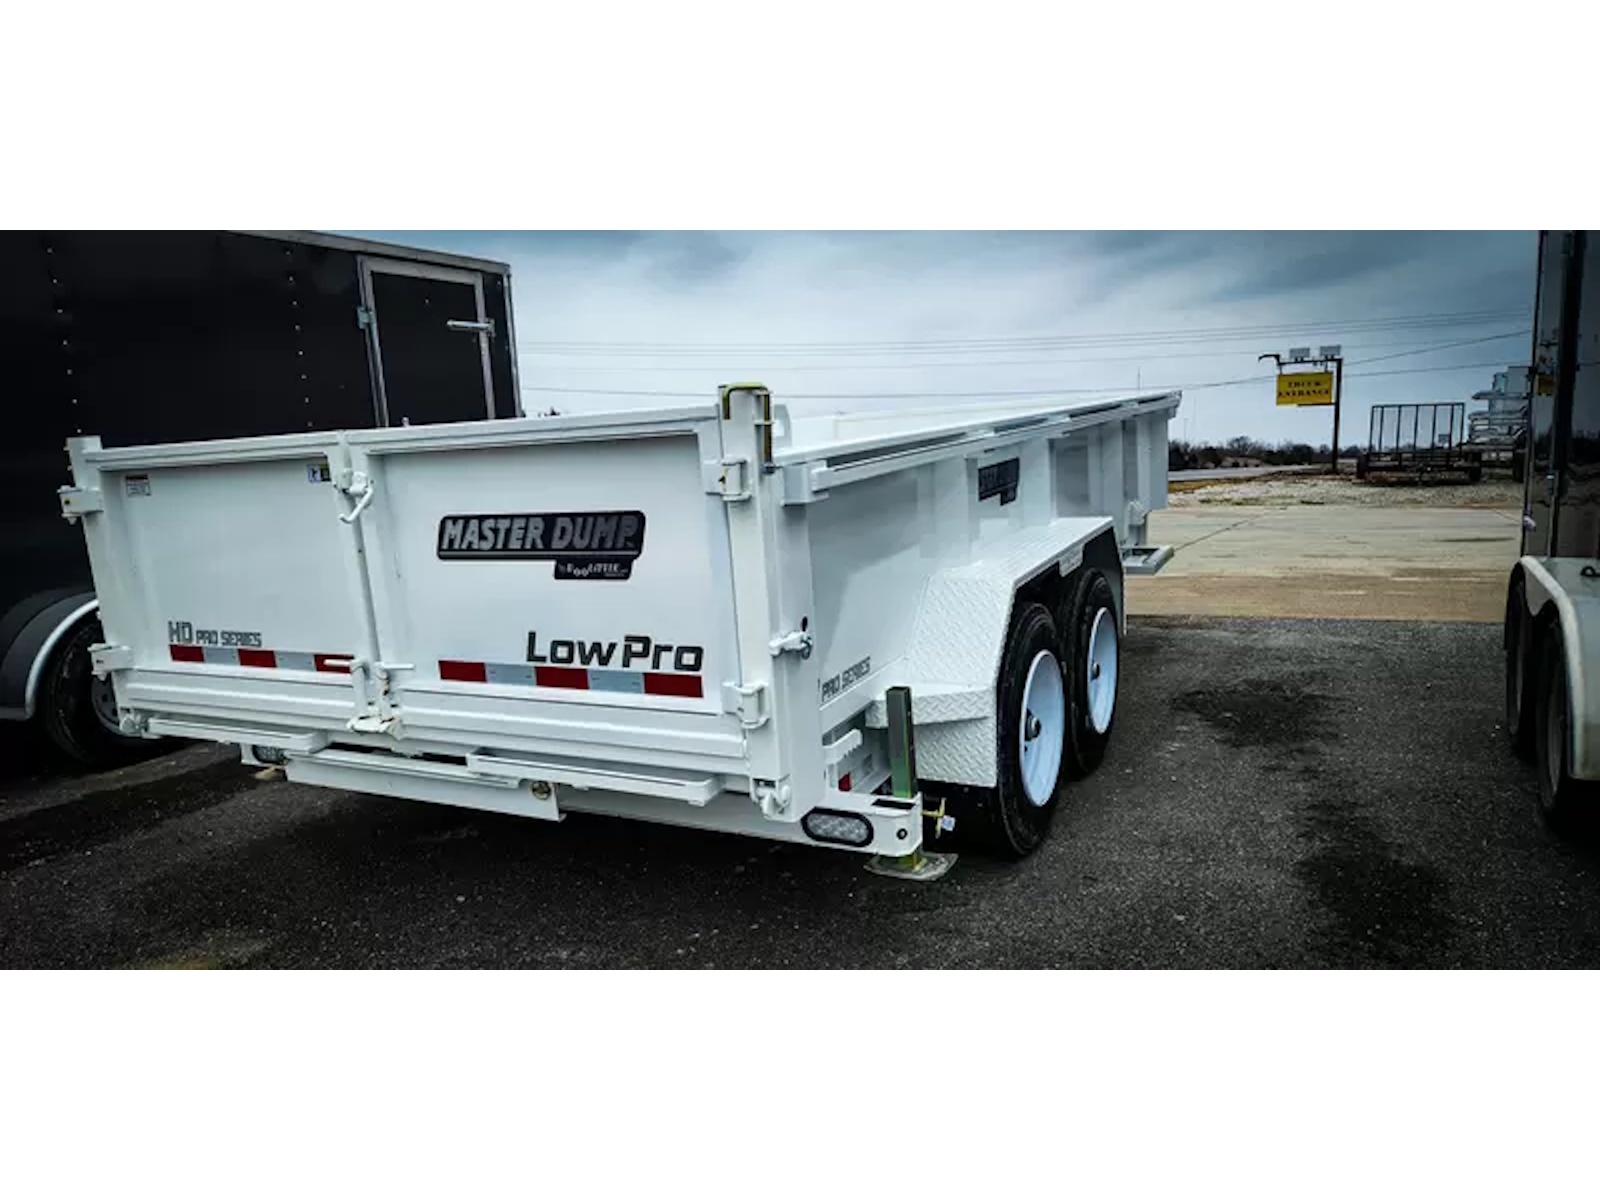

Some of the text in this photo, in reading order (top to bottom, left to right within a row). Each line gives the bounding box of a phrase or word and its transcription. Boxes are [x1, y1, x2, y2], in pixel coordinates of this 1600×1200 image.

[440, 515, 638, 550] MASTER DUMP
[168, 621, 262, 648] HD PRO SERIES
[822, 674, 840, 702] PRO
[842, 655, 870, 690] SERIES
